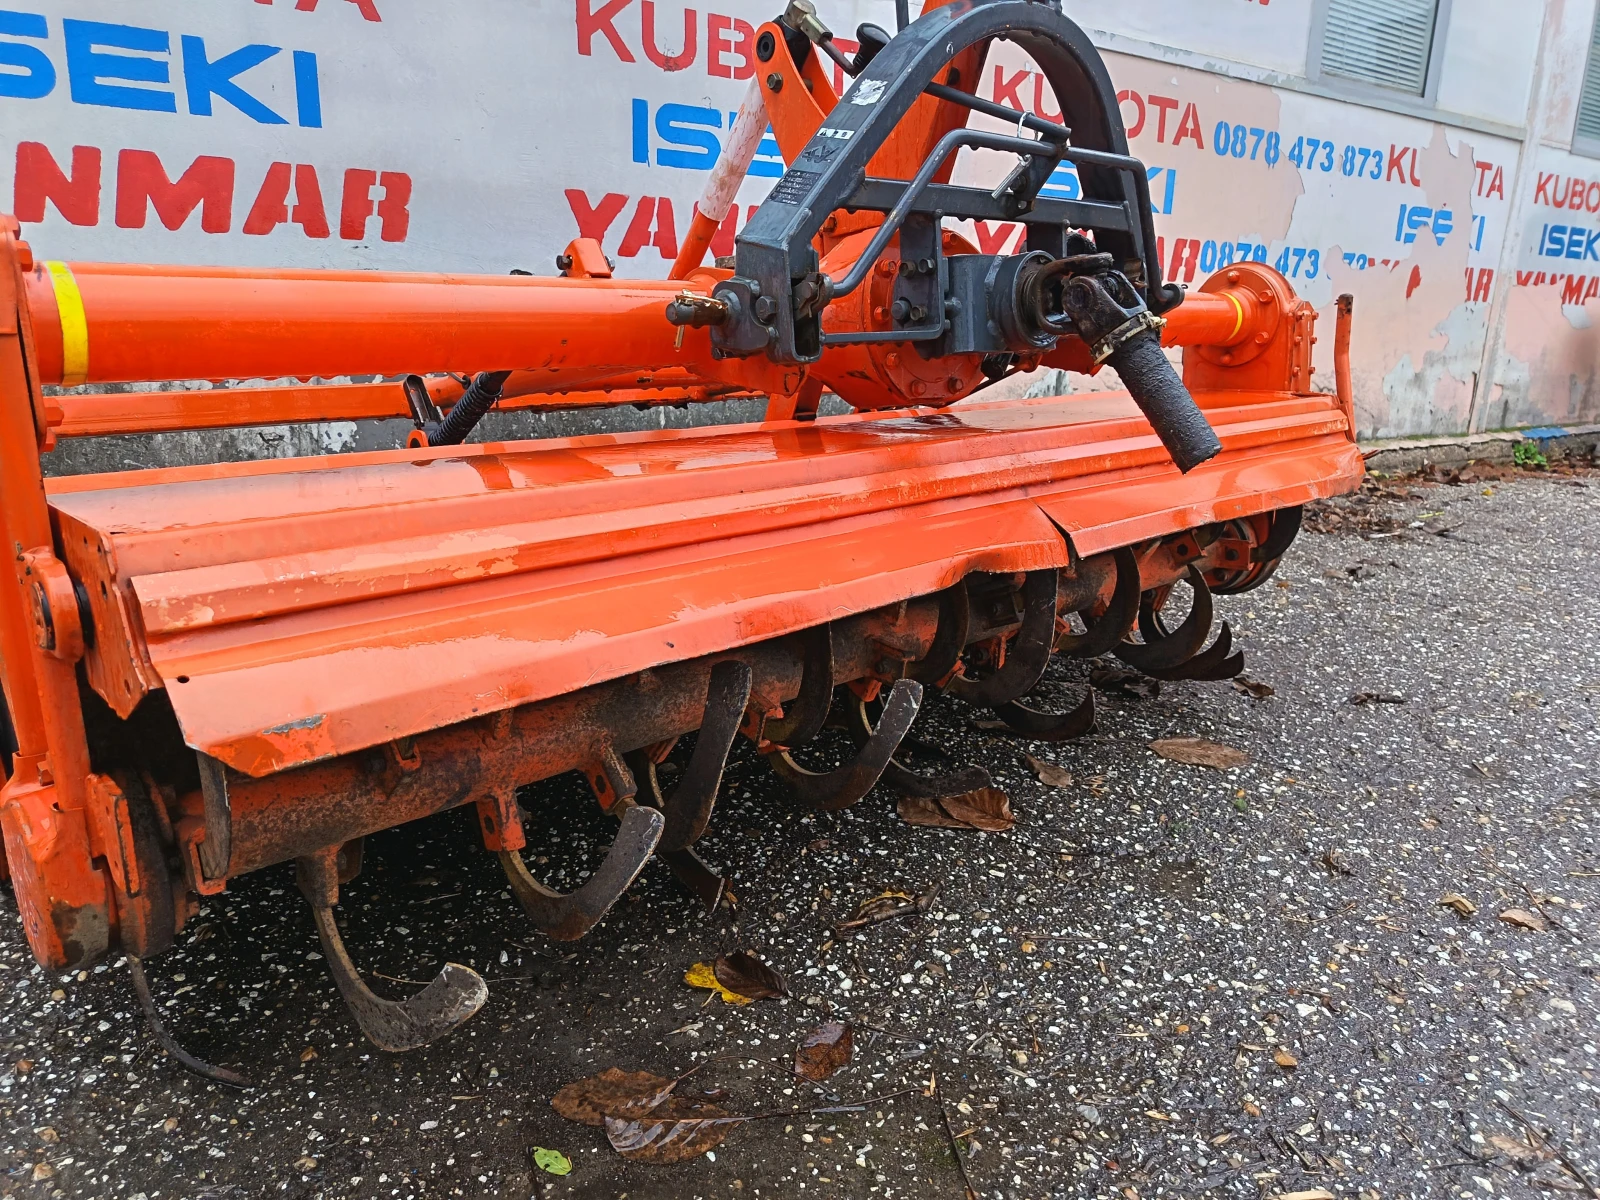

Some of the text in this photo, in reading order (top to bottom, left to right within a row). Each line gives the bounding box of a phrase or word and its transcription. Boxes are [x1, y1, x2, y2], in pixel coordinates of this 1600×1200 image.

[993, 64, 1204, 149] KUOTA
[1213, 120, 1383, 180] 0878 473 873
[13, 141, 412, 242] NMAR
[1395, 203, 1486, 252] ISEI
[1275, 246, 1320, 279] 473
